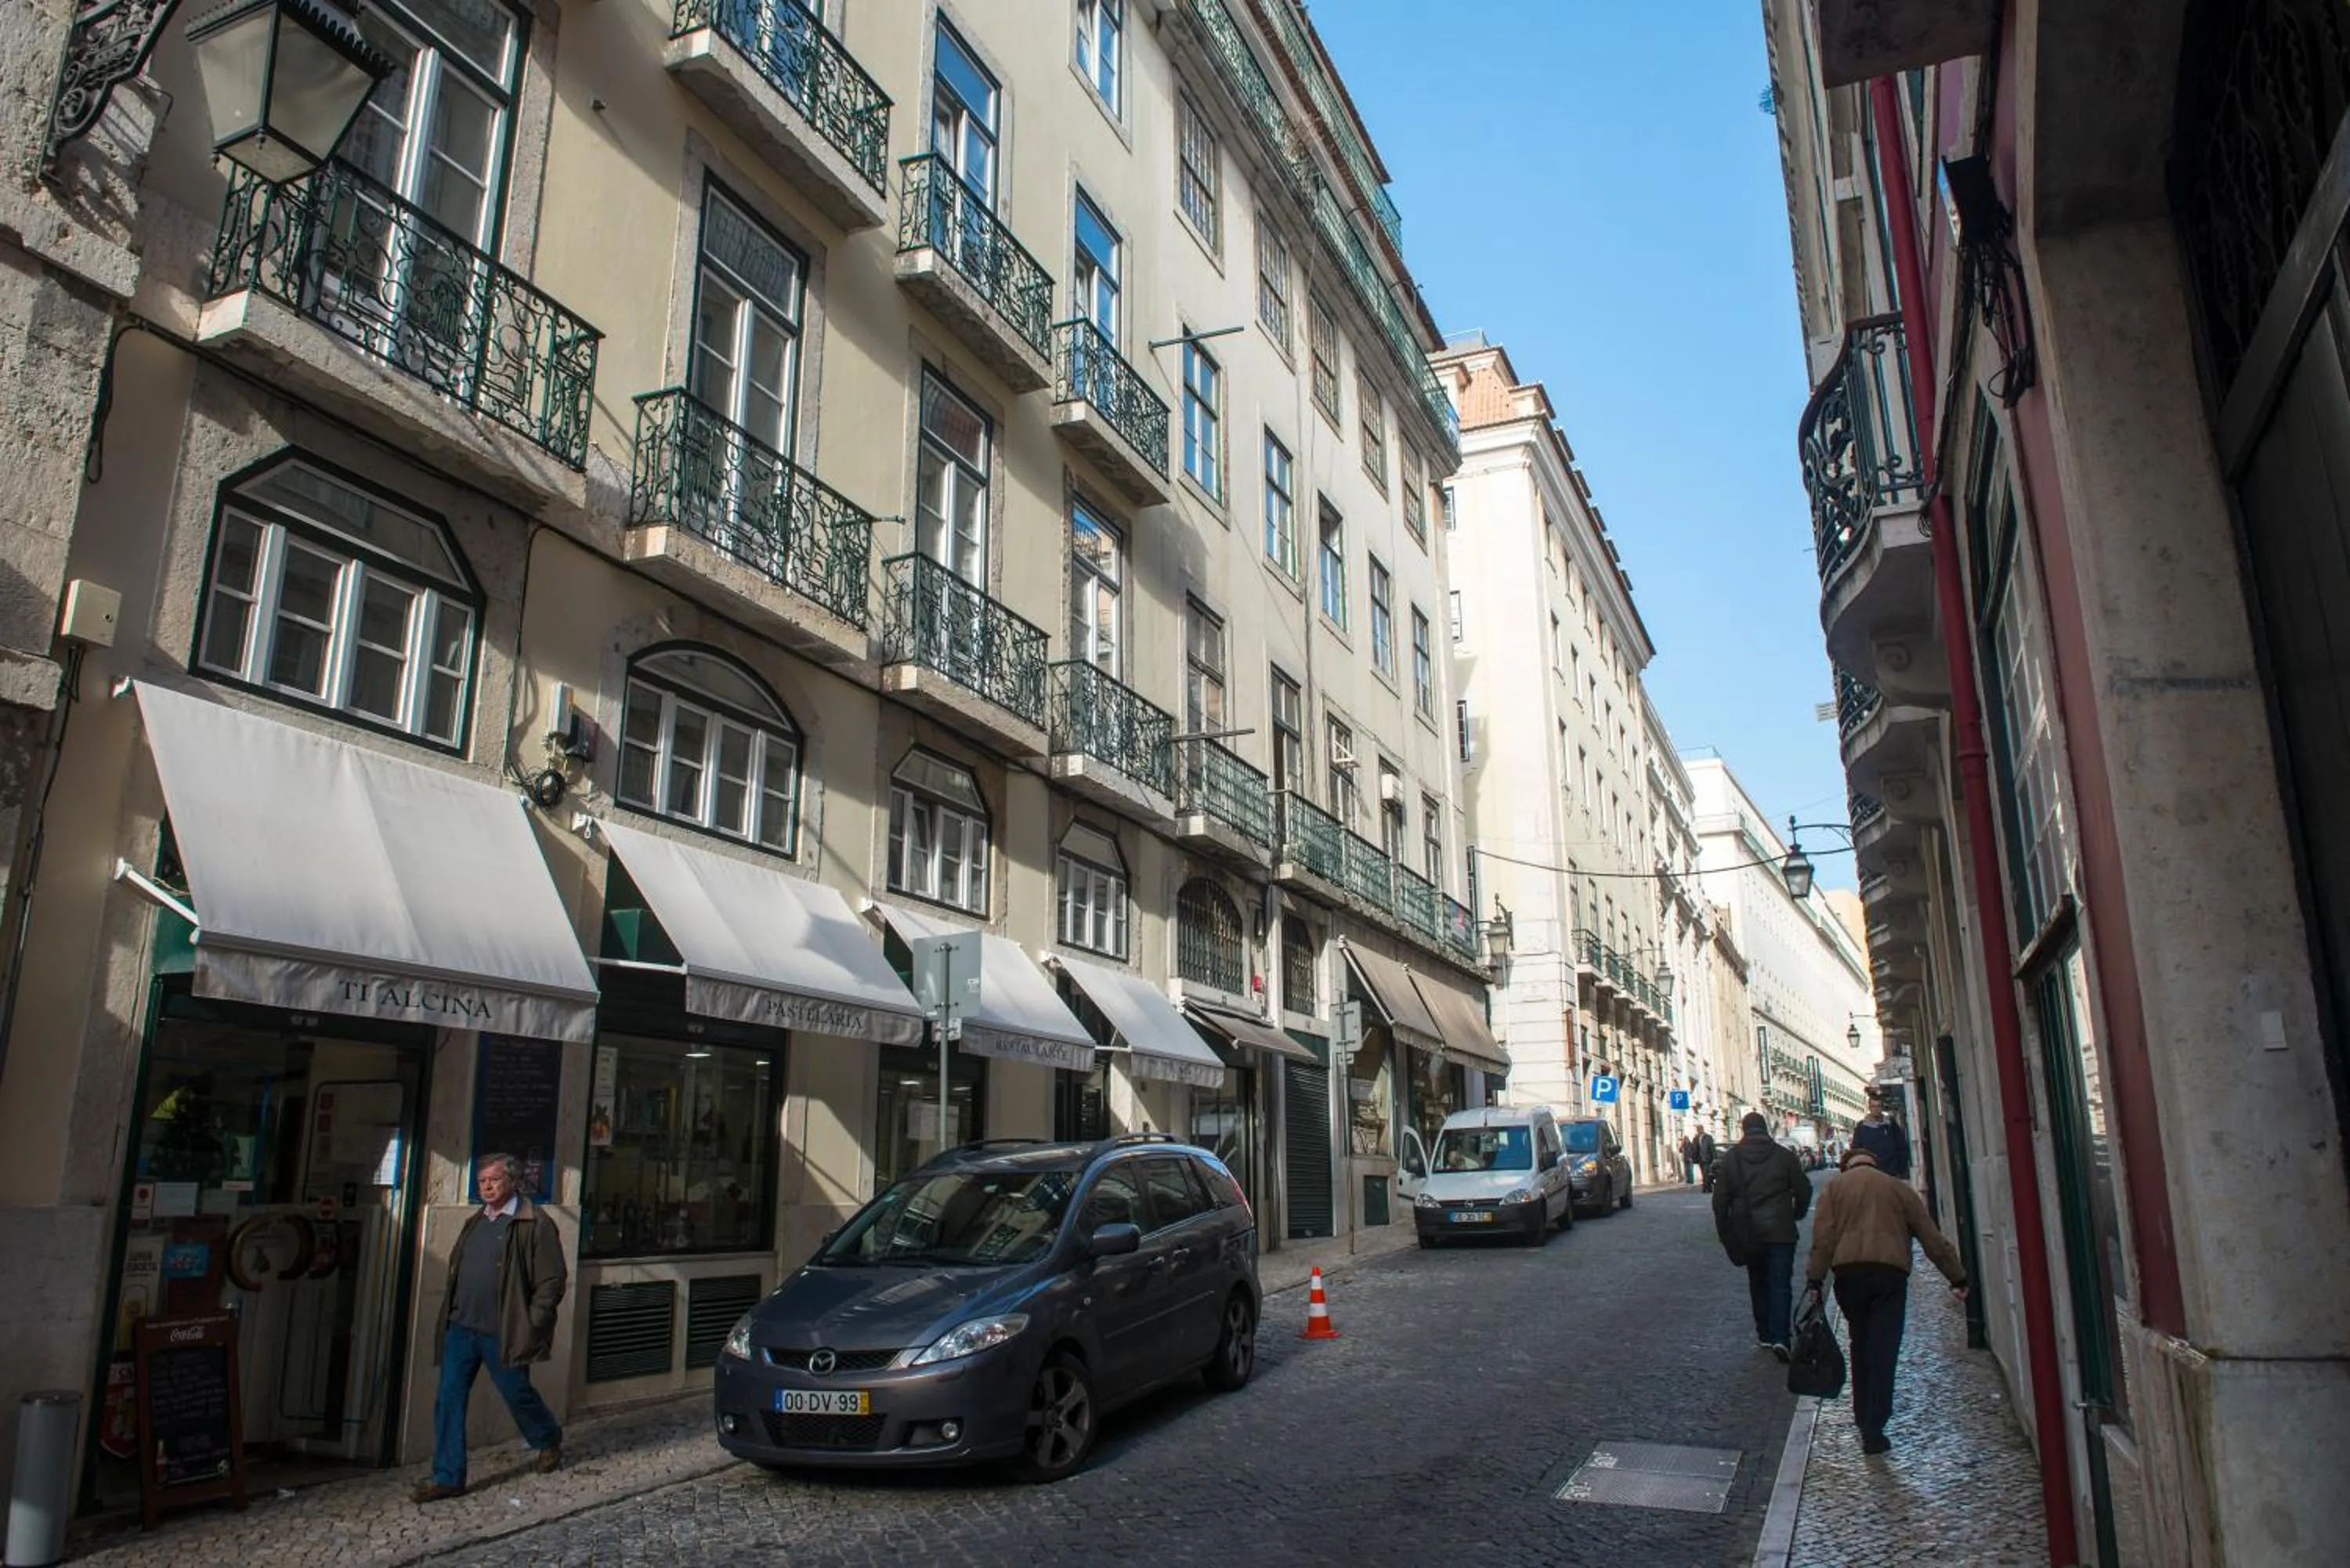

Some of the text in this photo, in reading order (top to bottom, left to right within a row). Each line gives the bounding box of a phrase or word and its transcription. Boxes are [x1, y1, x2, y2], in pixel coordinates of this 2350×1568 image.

[338, 980, 491, 1018] TI ALCINA
[766, 1000, 865, 1029] PASTELARIA
[1596, 1078, 1612, 1099] P
